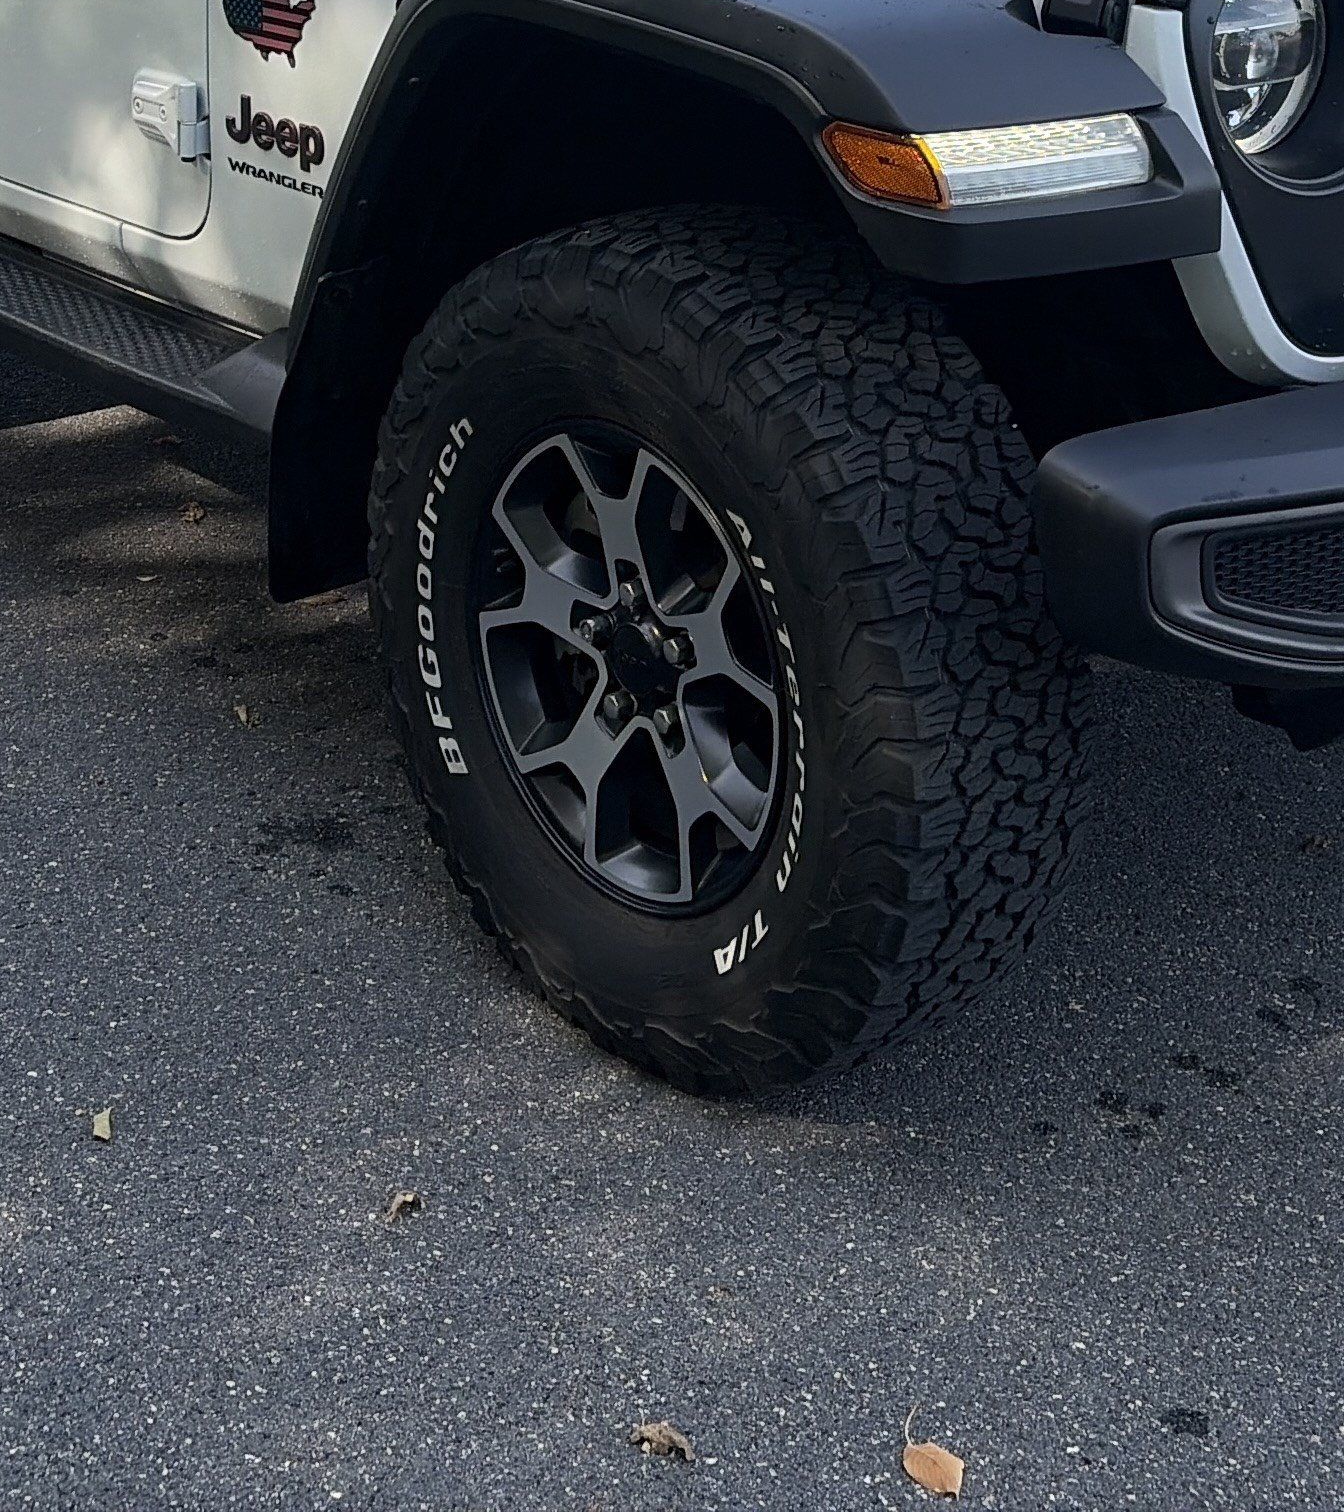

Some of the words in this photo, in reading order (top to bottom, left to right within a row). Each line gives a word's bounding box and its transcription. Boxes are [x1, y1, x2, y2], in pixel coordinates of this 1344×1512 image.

[225, 94, 325, 173] Jeep
[228, 156, 323, 199] WRANGLER
[413, 416, 474, 776] BFGoodrich
[725, 508, 806, 894] All-Terrain
[713, 909, 770, 977] T/A
